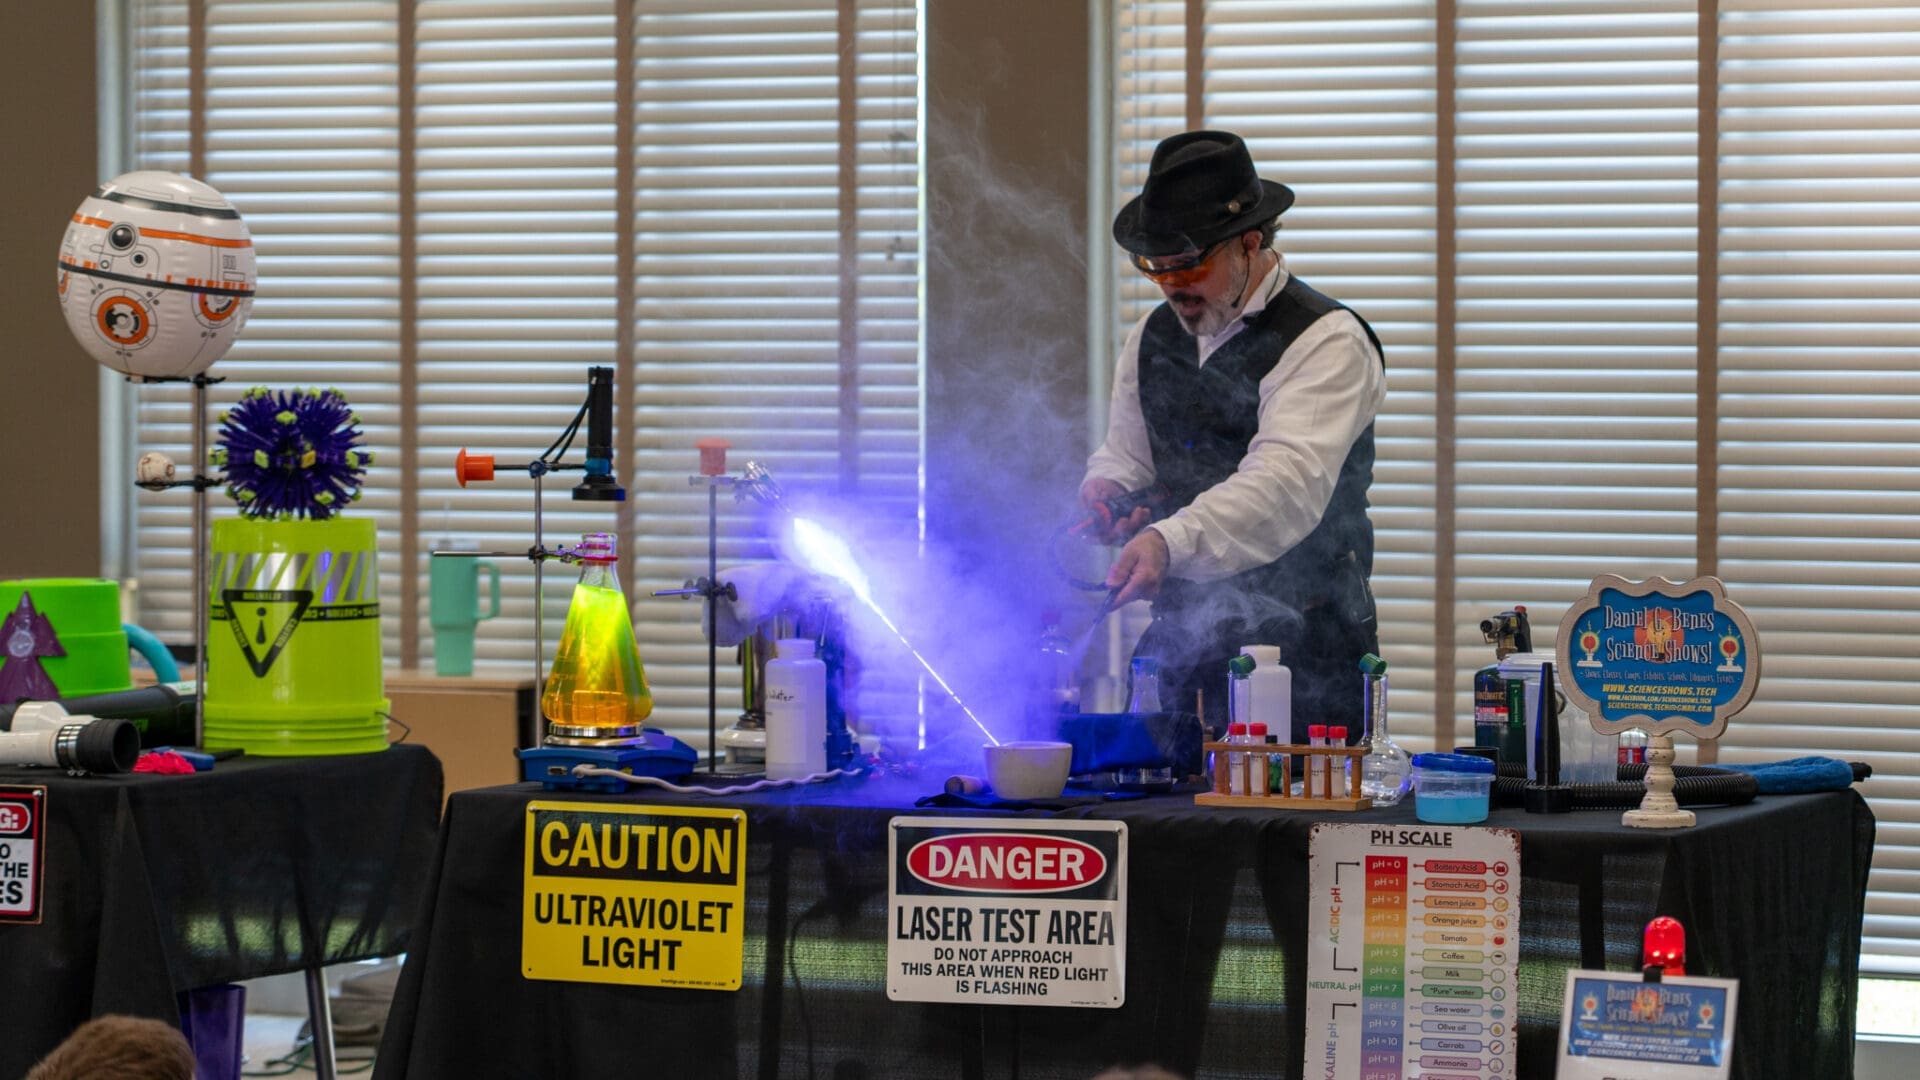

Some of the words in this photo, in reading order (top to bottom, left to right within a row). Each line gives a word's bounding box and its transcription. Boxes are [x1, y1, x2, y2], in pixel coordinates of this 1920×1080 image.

[540, 820, 732, 874] CAUTION
[1371, 830, 1393, 845] PH
[1399, 831, 1452, 846] SCALE
[928, 845, 1085, 881] DANGER
[534, 892, 733, 933] ULTRAVIOLET
[897, 906, 972, 942] LASER
[979, 908, 1040, 944] TEST
[1046, 910, 1115, 946] AREA
[582, 935, 682, 971] LIGHT
[934, 947, 953, 961] DO
[958, 948, 987, 962] NOT
[991, 949, 1072, 964] APPROACH
[901, 962, 932, 976] THIS
[936, 963, 975, 977] AREA
[980, 965, 1024, 979] WHEN
[1029, 966, 1059, 980] RED
[1064, 967, 1108, 981] LIGHT
[956, 980, 969, 993] IS
[974, 981, 1048, 995] FLASHING
[1308, 981, 1347, 991] NEUTRAL
[1349, 983, 1361, 993] pH
